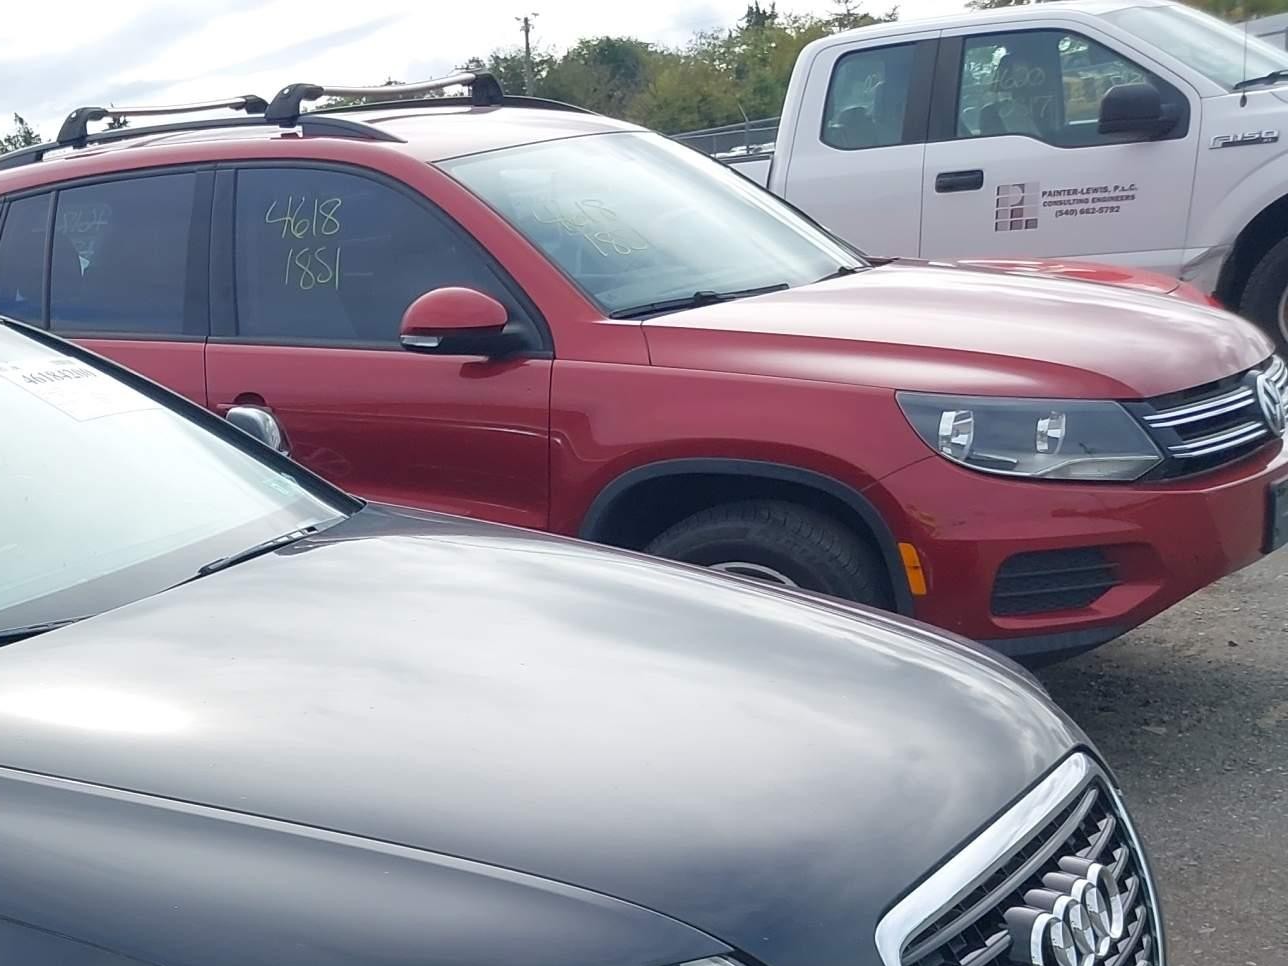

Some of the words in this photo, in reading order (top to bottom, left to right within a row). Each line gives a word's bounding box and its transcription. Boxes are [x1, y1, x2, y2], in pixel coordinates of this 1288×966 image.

[1042, 197, 1090, 207] CONSULTING
[1091, 194, 1136, 204] ENGINEERS
[1055, 207, 1078, 218] (540)
[264, 196, 343, 239] 4618
[284, 247, 342, 291] 1851
